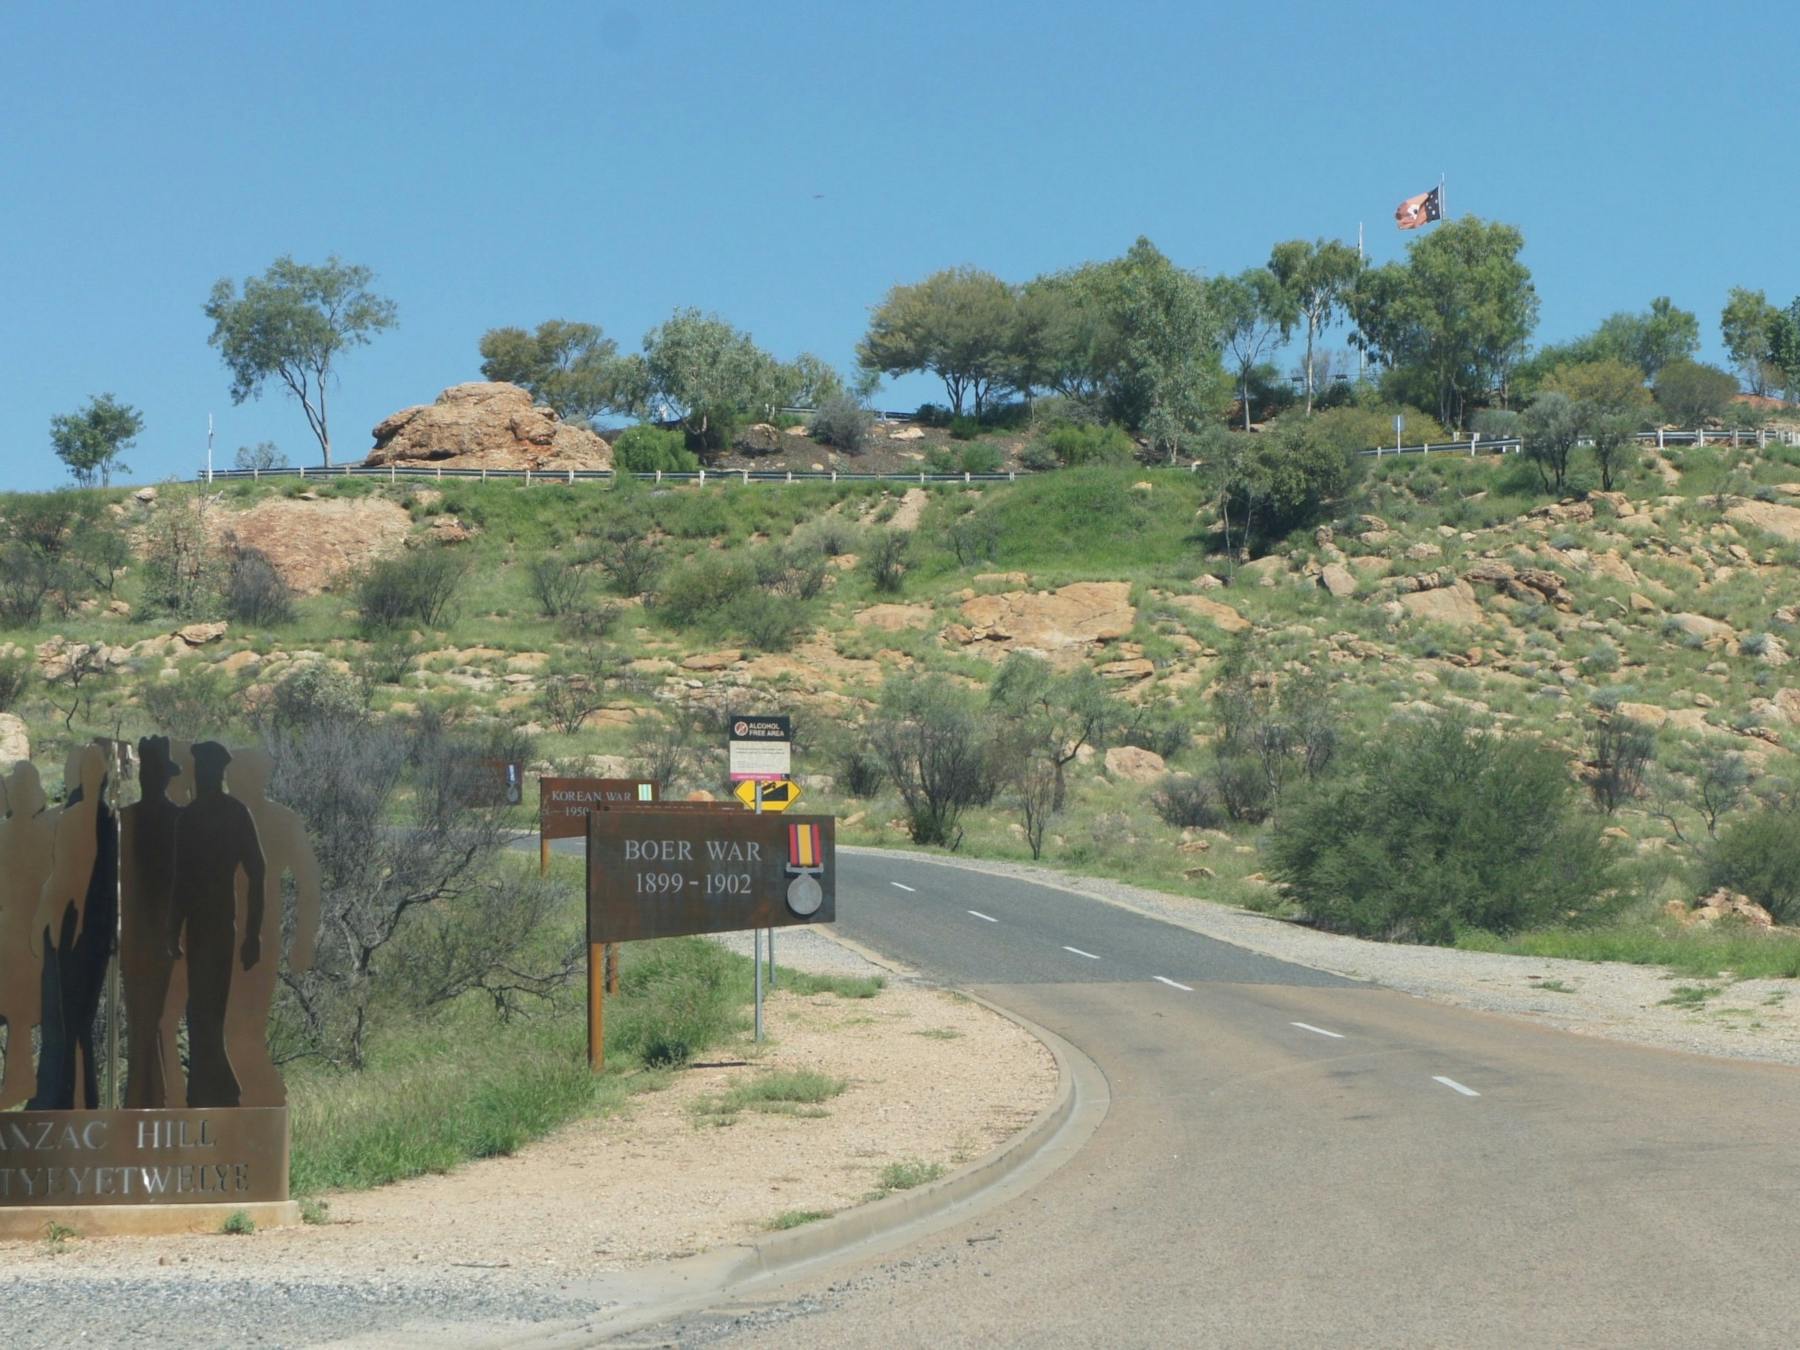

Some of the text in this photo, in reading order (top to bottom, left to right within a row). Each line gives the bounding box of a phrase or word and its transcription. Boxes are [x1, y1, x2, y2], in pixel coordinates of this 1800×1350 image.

[749, 722, 780, 730] ALCOHOL
[552, 790, 631, 801] KOREAN WAR
[625, 840, 762, 862] BOER WAR
[636, 873, 683, 893] 1899
[705, 874, 752, 894] 1902
[0, 1119, 217, 1150] NZAC HILL
